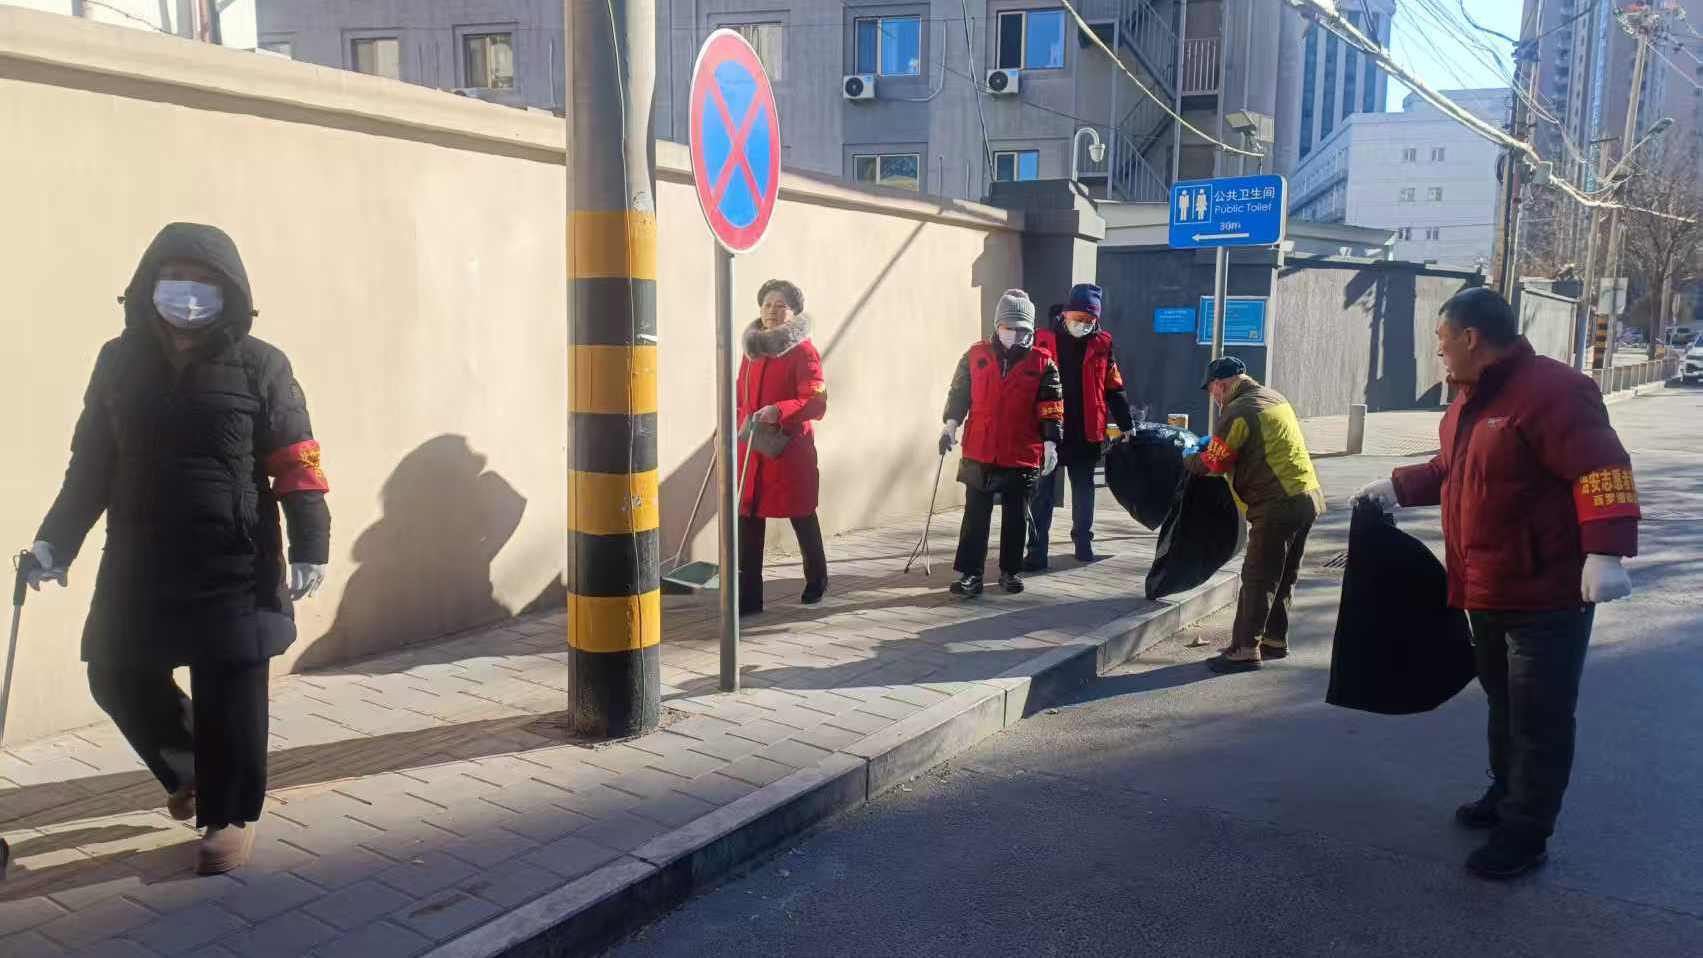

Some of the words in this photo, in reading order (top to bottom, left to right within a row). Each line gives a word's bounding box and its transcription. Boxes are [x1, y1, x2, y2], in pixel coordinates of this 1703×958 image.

[1214, 186, 1275, 201] 公共卫生间
[1214, 204, 1244, 215] Public
